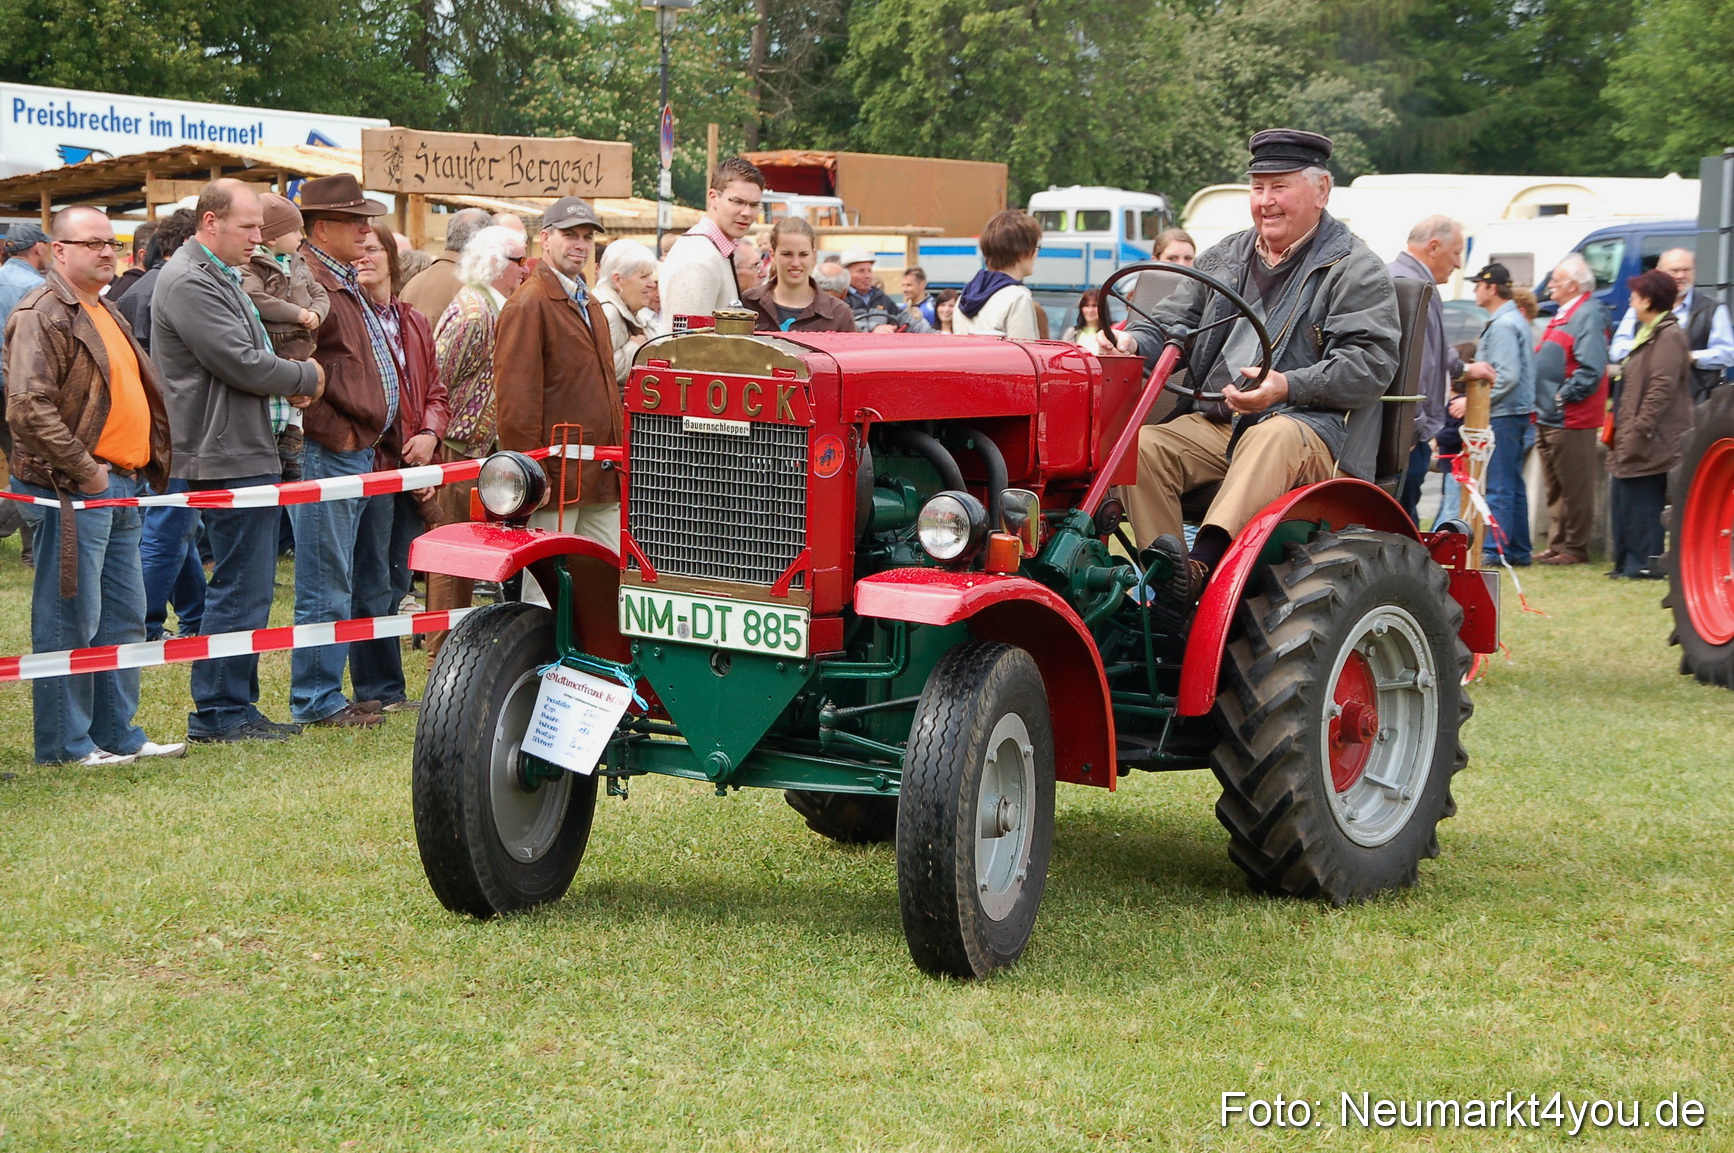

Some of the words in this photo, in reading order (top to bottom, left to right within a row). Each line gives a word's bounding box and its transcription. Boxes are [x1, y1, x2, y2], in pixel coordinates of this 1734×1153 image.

[13, 97, 142, 135] Preisbrecher
[150, 111, 173, 137] im
[181, 114, 264, 147] Internet!
[414, 140, 500, 191] Staufer
[503, 144, 604, 194] Bergesel
[640, 374, 797, 421] STOCK
[743, 609, 802, 651] 885
